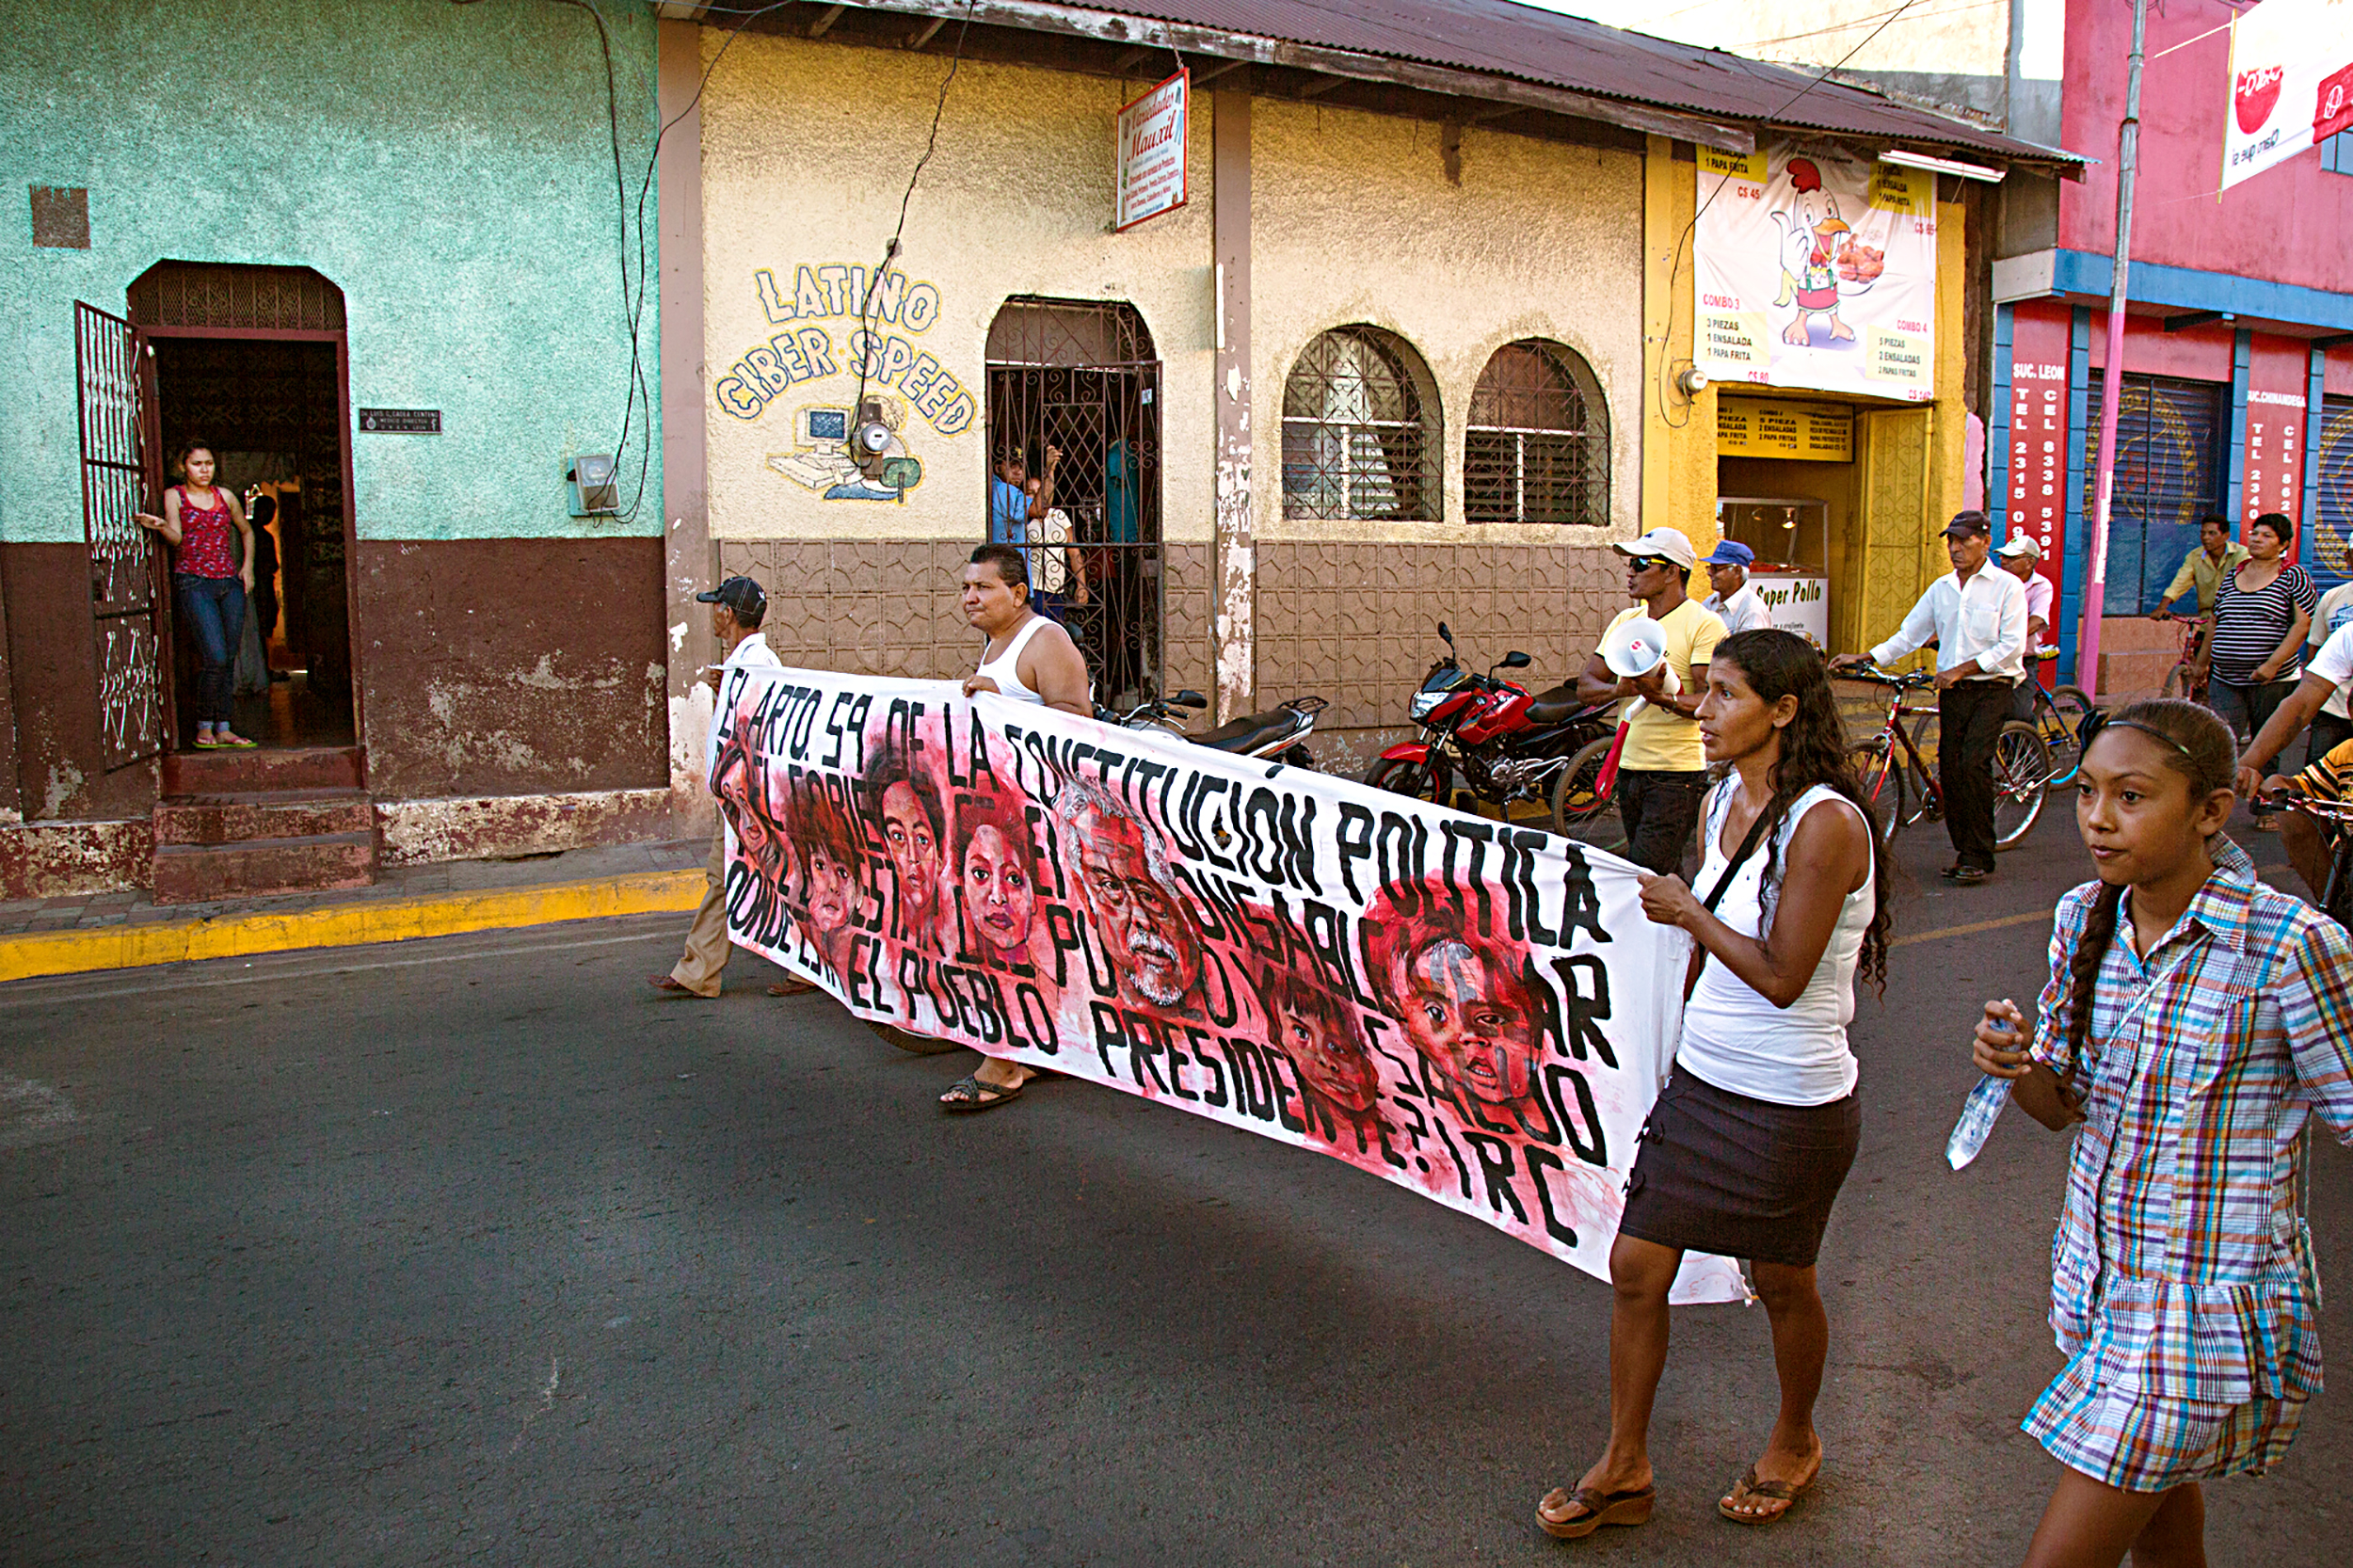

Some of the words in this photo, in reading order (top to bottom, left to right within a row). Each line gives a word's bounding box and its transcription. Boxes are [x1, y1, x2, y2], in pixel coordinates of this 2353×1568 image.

[1711, 158, 1728, 170] PAPA
[755, 264, 940, 333] LATINO
[1704, 294, 1733, 309] COMBO
[1735, 298, 1739, 310] 3
[1707, 318, 1711, 328] 3
[1713, 319, 1738, 330] PIEZAS
[1714, 333, 1752, 346] ENSALADA
[1884, 338, 1905, 348] PIEZAS
[1897, 319, 1921, 332] COMBO
[1923, 323, 1927, 333] 4
[1714, 348, 1729, 358] PAPA
[1730, 350, 1751, 360] FRITA
[1884, 351, 1921, 364] ENSALADAS
[2013, 363, 2037, 378] SUC.
[2039, 364, 2064, 380] LEON
[716, 327, 840, 420] CIBER
[850, 329, 977, 436] SPEED
[2015, 388, 2029, 430] TEL
[2043, 390, 2057, 430] CEL
[2251, 424, 2264, 459] TEL
[2282, 425, 2295, 464] CEL
[2013, 441, 2027, 500] 2315
[2041, 440, 2055, 496] 8338
[2249, 470, 2261, 520] 2340
[2281, 473, 2291, 518] 862
[2040, 507, 2053, 561] 5391
[1756, 584, 1788, 612] Super
[1793, 579, 1821, 604] Pollo
[717, 667, 744, 739] EL
[822, 692, 873, 773] 59
[886, 696, 934, 783] DE
[943, 703, 1000, 792] LA
[726, 859, 792, 954] DONDE
[847, 932, 894, 1015] EL
[899, 946, 1059, 1056] PUEBLO
